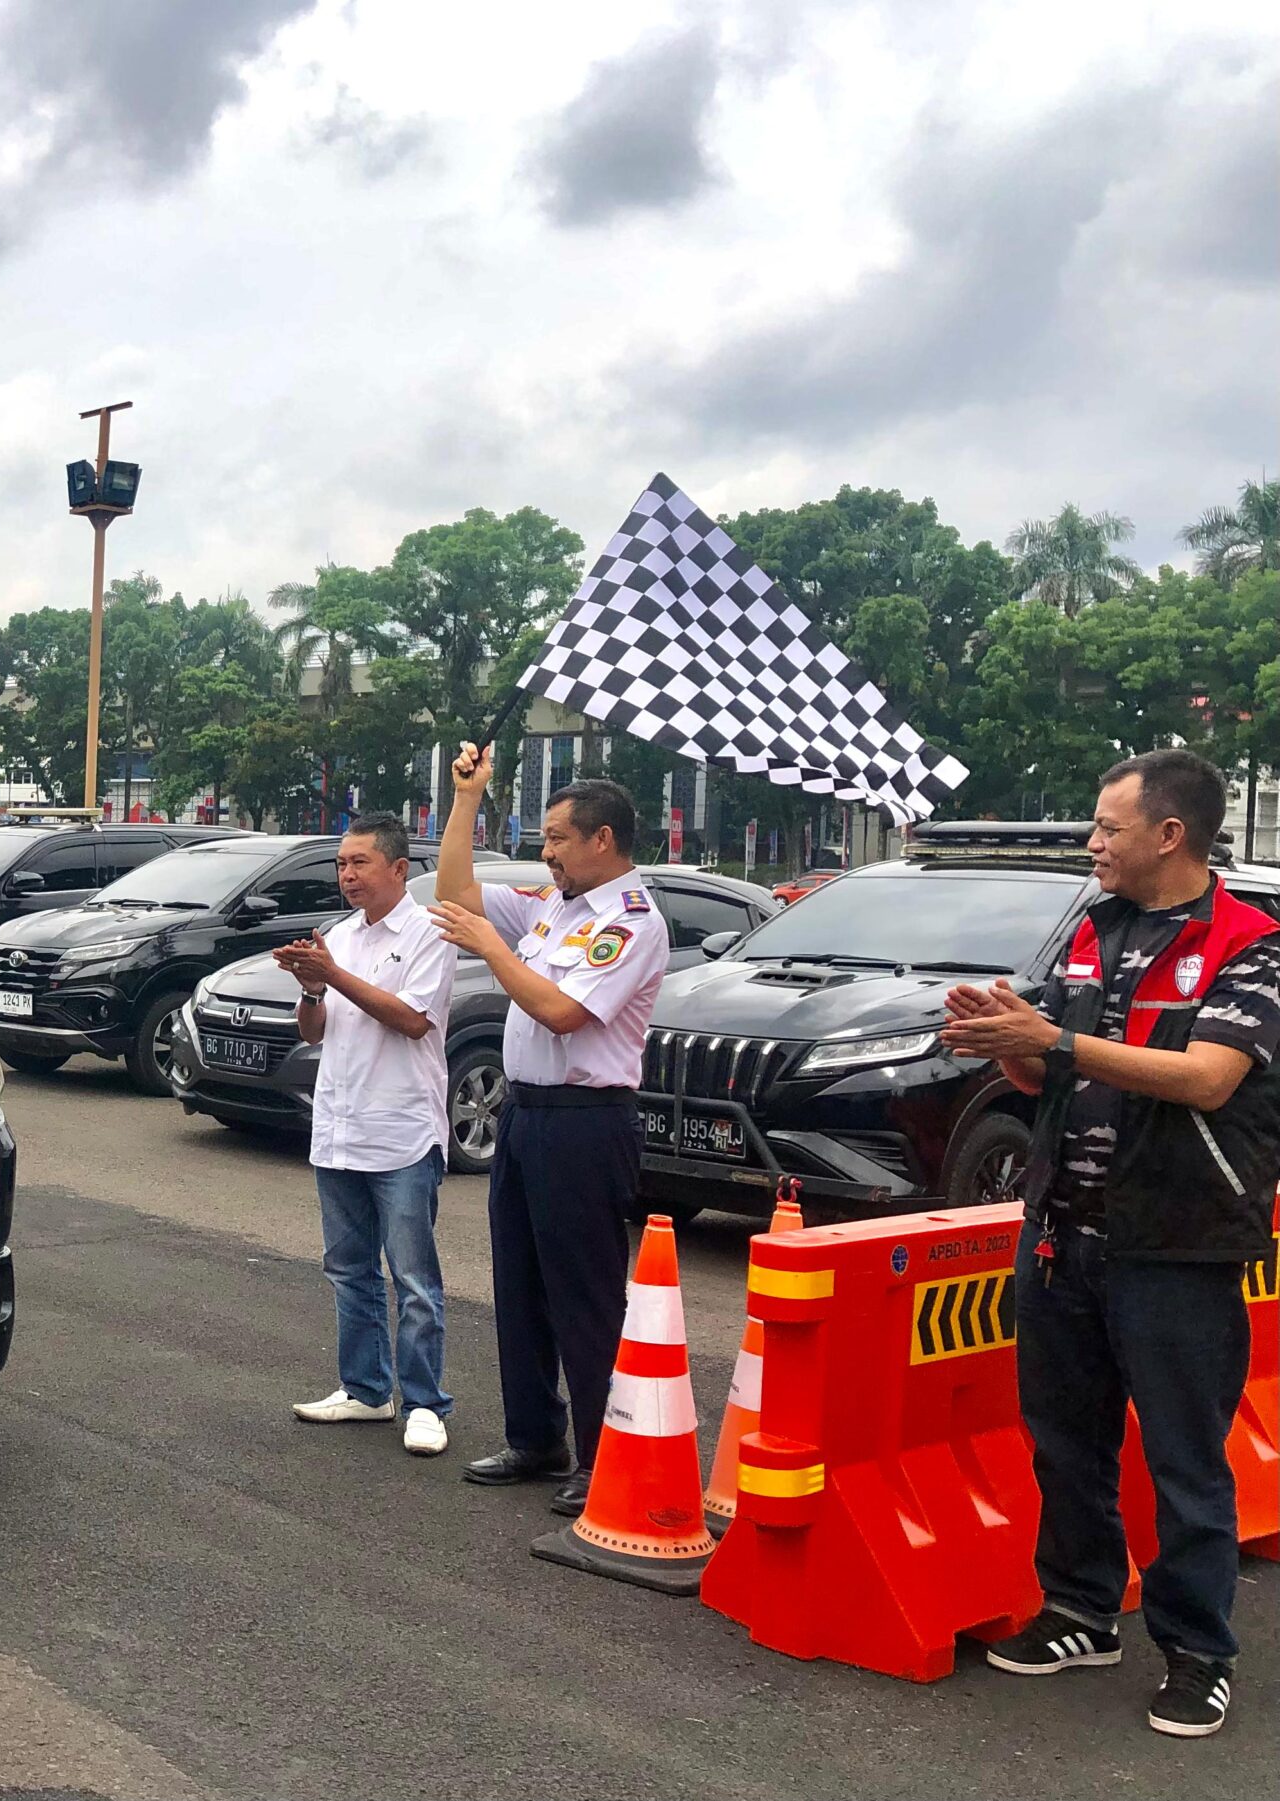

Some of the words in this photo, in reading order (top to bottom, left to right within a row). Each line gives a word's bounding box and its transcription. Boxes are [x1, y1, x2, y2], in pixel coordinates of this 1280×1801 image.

[22, 995, 31, 1008] PX
[206, 1037, 218, 1054] BG
[224, 1040, 246, 1058] 1710
[252, 1044, 264, 1061] PX
[647, 1112, 666, 1134] BG
[683, 1117, 716, 1142] 1954
[928, 1240, 962, 1262] APBD
[985, 1233, 1012, 1253] 2023
